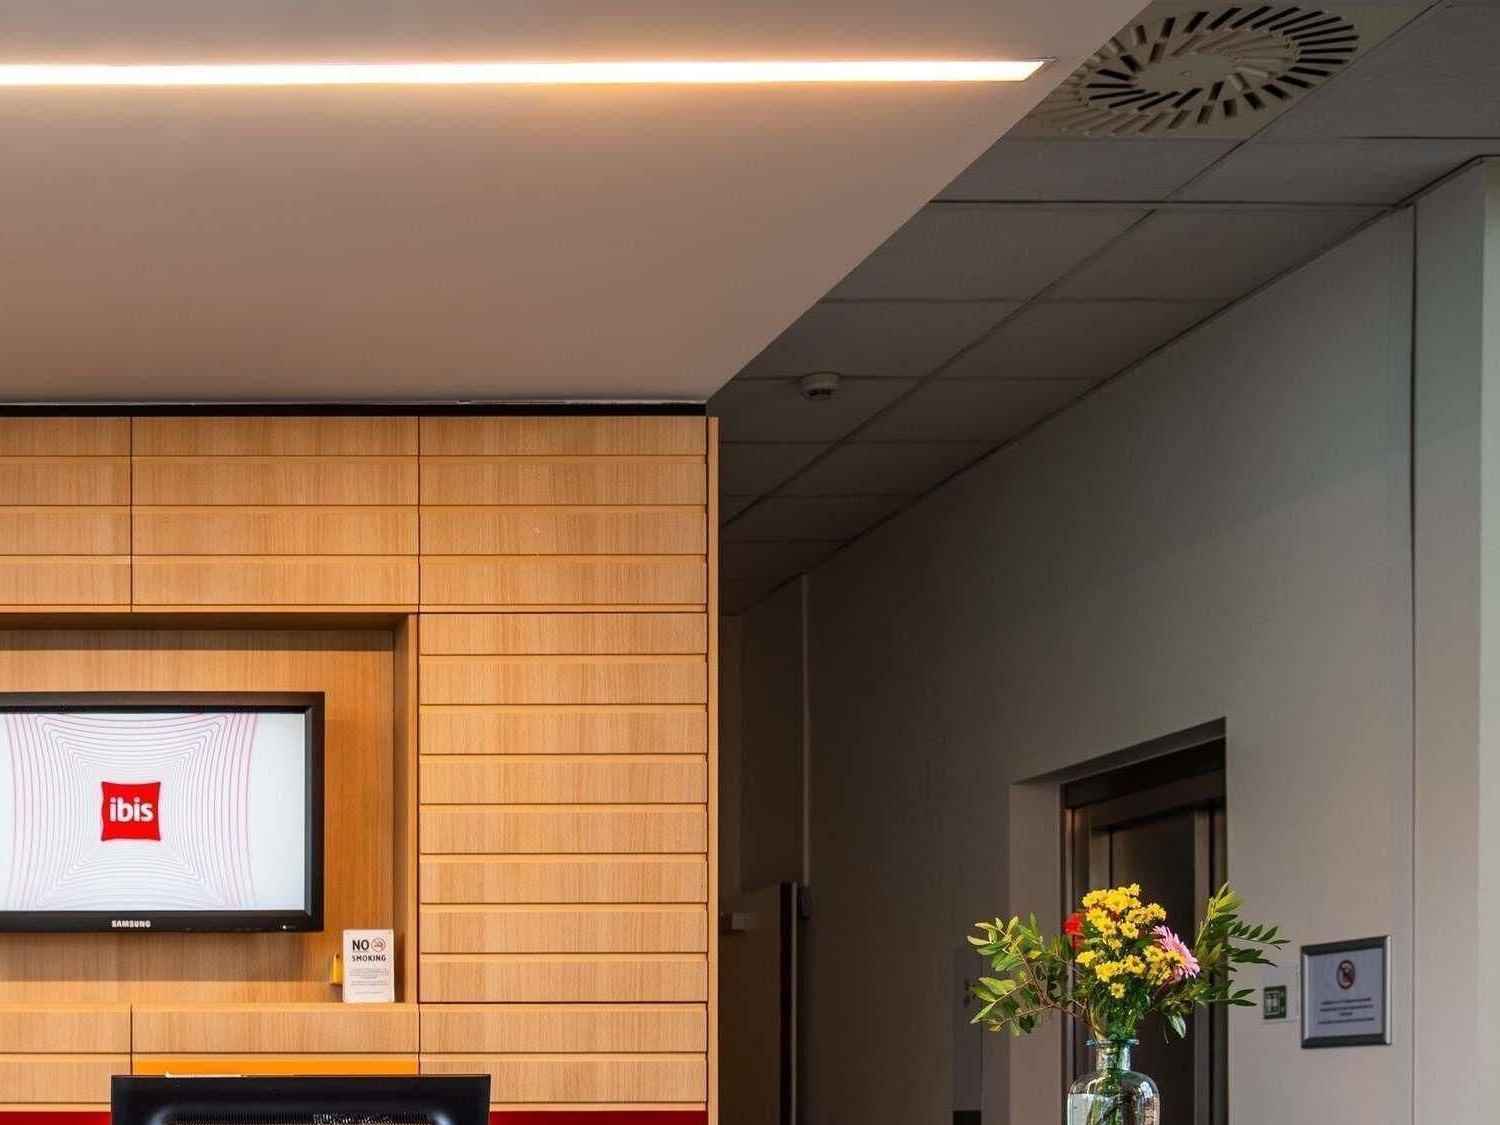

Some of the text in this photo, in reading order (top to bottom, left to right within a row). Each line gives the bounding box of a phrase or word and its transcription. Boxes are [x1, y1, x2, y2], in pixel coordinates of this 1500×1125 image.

[109, 796, 154, 823] ibis
[111, 919, 151, 928] SAMSUNG
[352, 939, 370, 951] NO
